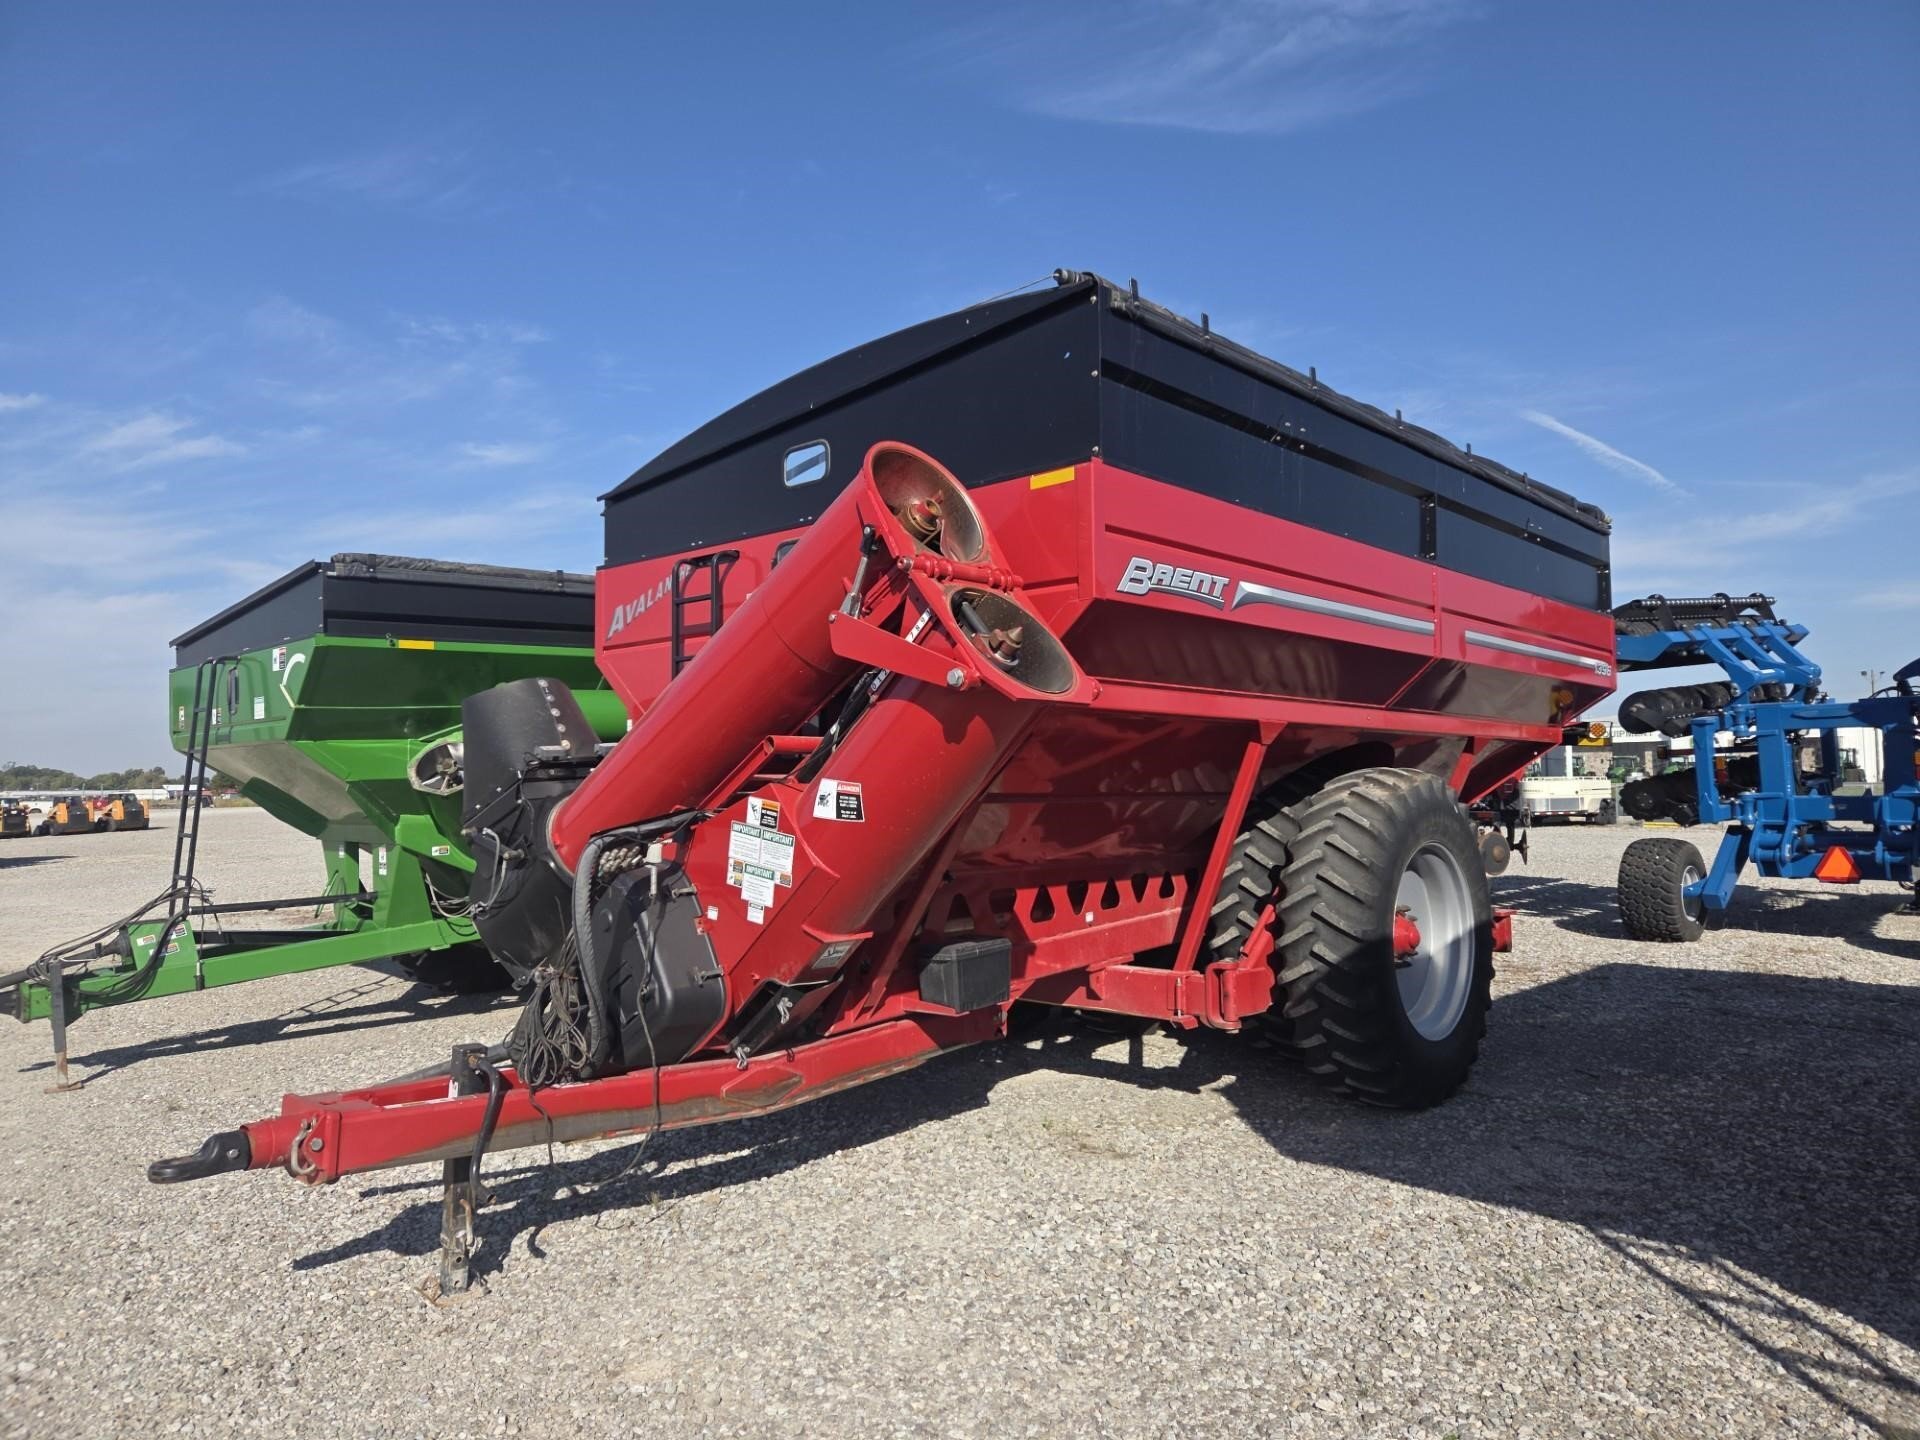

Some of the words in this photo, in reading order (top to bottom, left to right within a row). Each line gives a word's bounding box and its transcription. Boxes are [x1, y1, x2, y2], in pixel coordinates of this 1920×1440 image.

[1116, 556, 1230, 598] BRENT
[607, 563, 691, 640] AVALANHE
[732, 824, 761, 837] IMPORTANT
[763, 831, 793, 846] IMPORTANT
[746, 865, 773, 879] IMPORTANT
